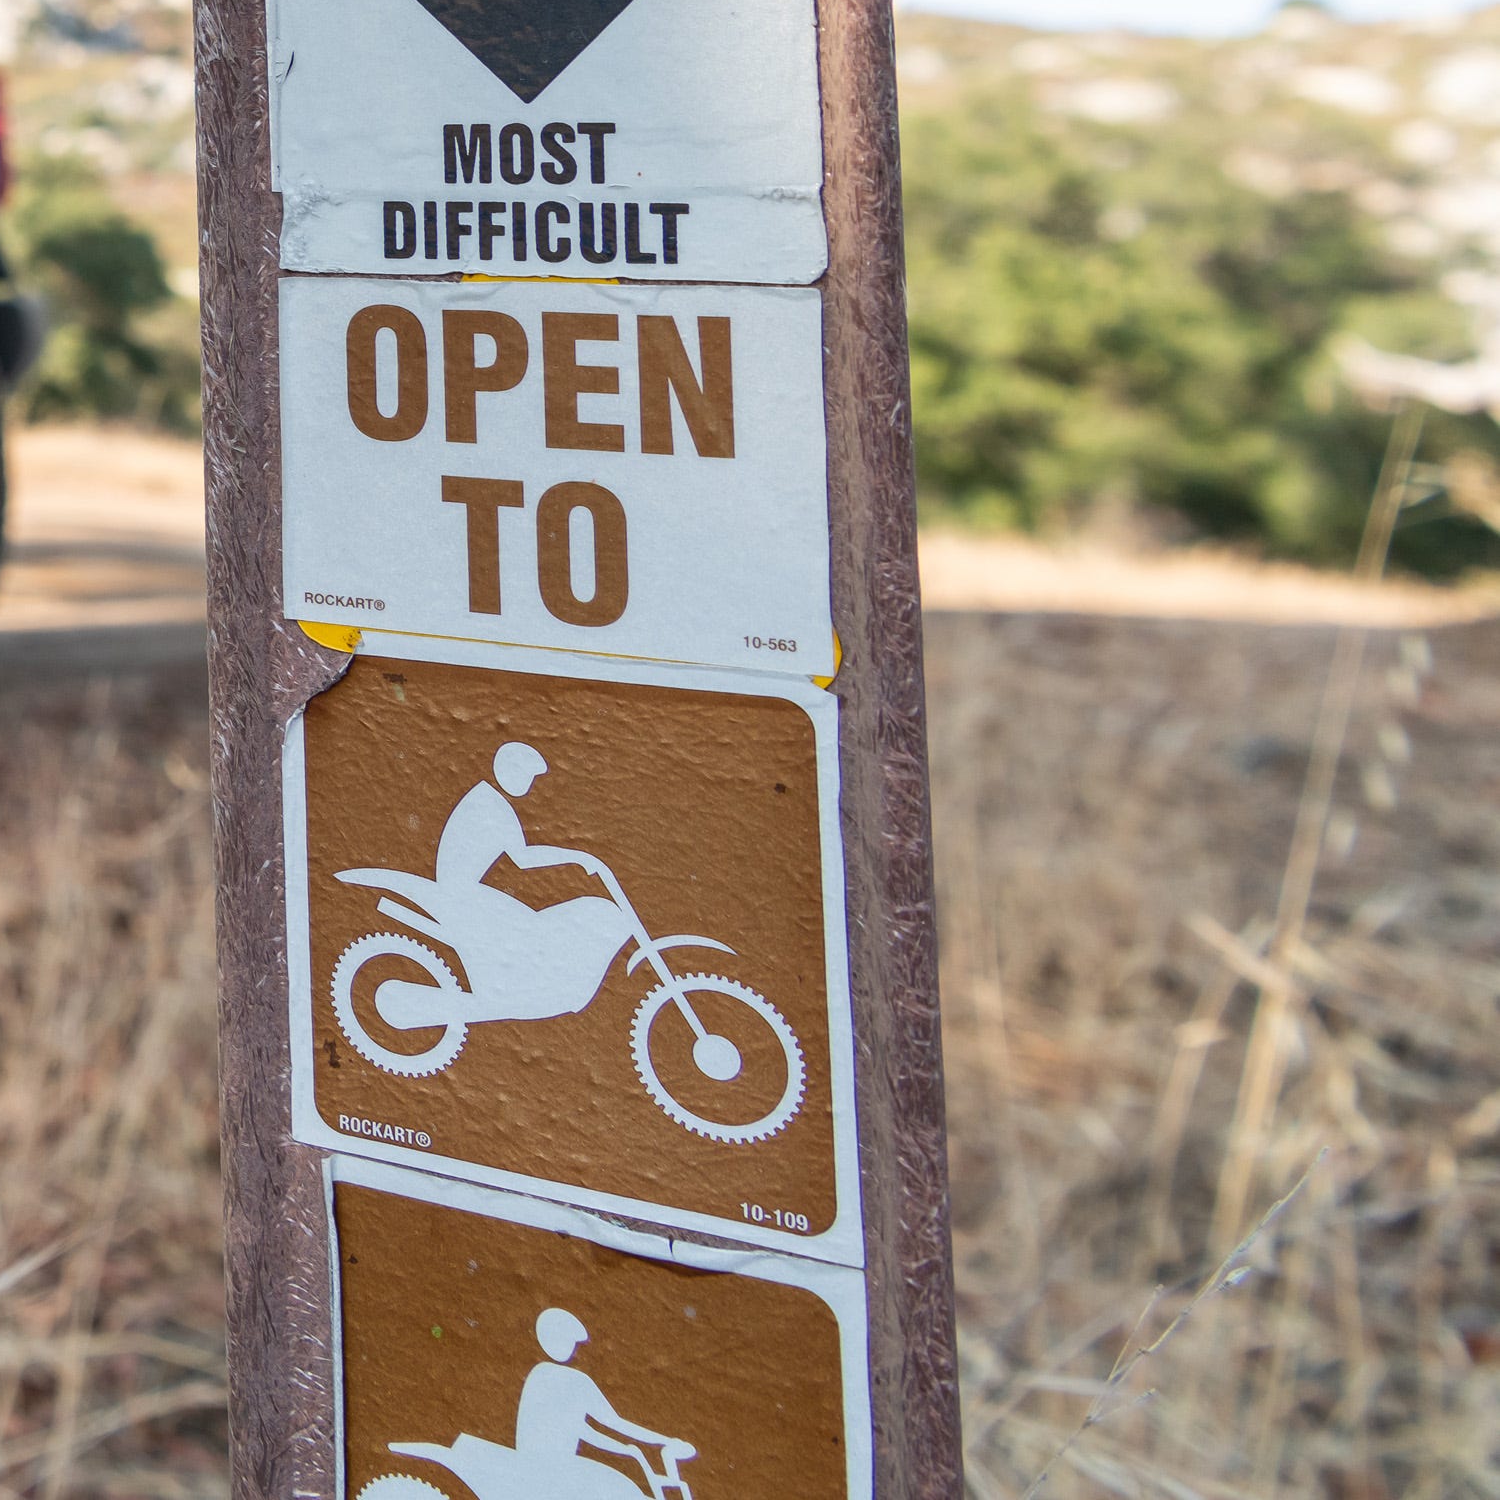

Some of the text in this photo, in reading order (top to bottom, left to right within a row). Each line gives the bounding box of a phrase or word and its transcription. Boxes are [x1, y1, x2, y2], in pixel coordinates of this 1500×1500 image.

[442, 121, 616, 186] MOST
[382, 200, 690, 265] DIFFICULT
[346, 303, 736, 460] OPEN
[440, 474, 630, 628] TO
[742, 635, 799, 653] 10-563
[739, 1201, 810, 1232] 10-109
